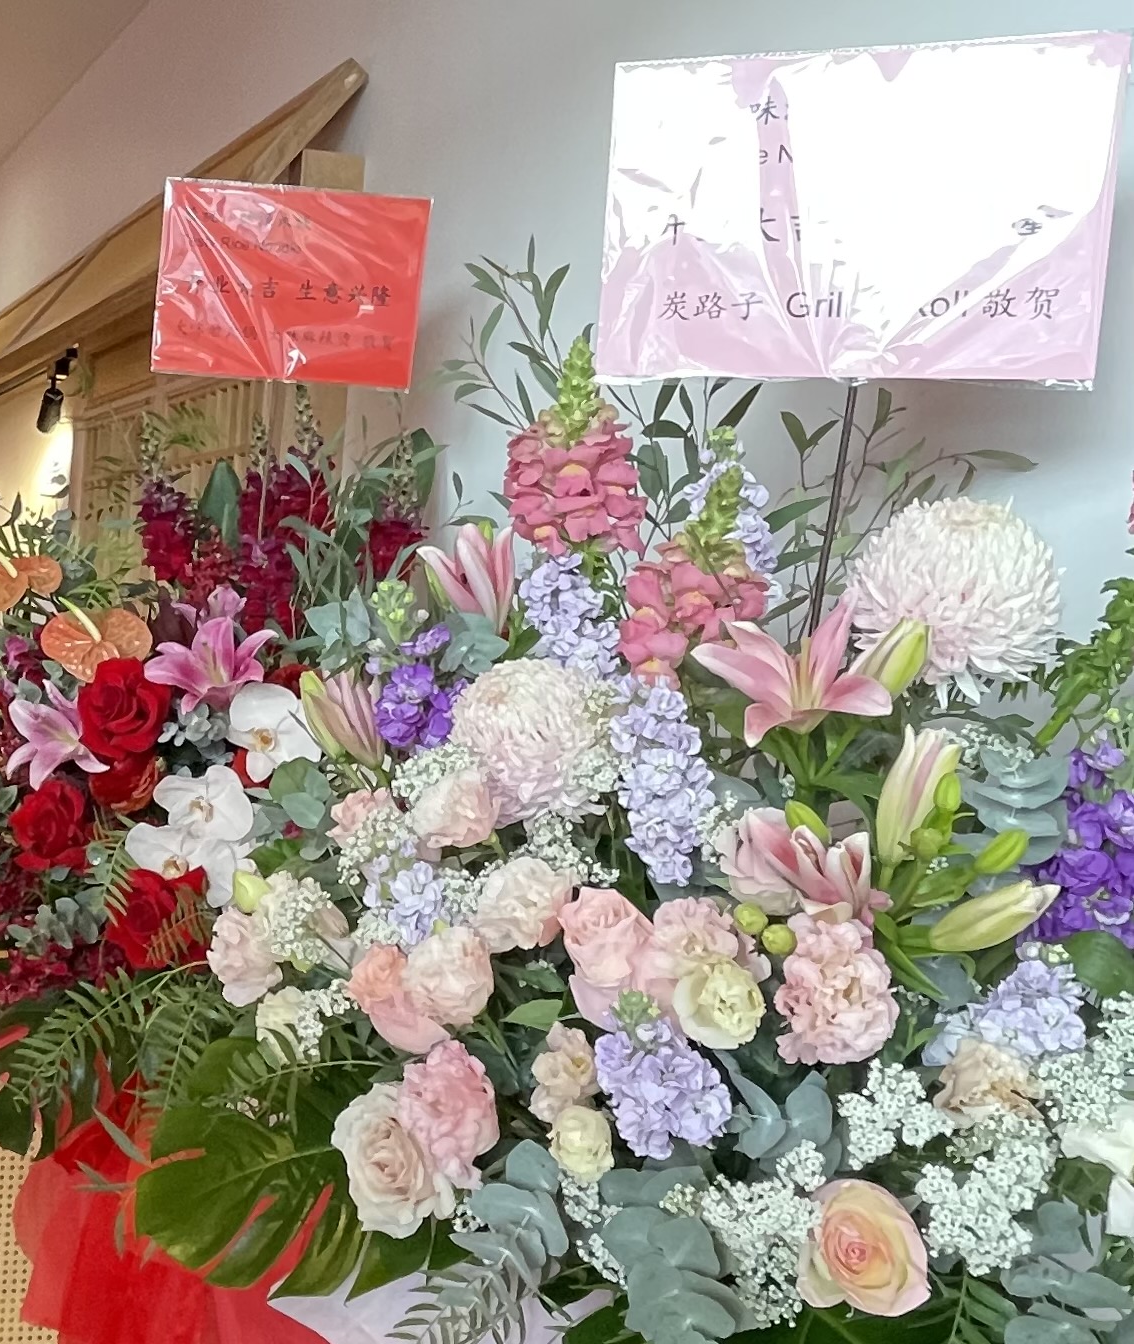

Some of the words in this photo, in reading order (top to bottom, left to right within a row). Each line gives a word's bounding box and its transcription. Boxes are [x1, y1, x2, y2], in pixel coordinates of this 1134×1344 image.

[296, 279, 391, 307] 生意兴隆
[657, 291, 763, 321] 炭路子
[786, 291, 845, 318] Gril
[982, 286, 1060, 321] 敬贺
